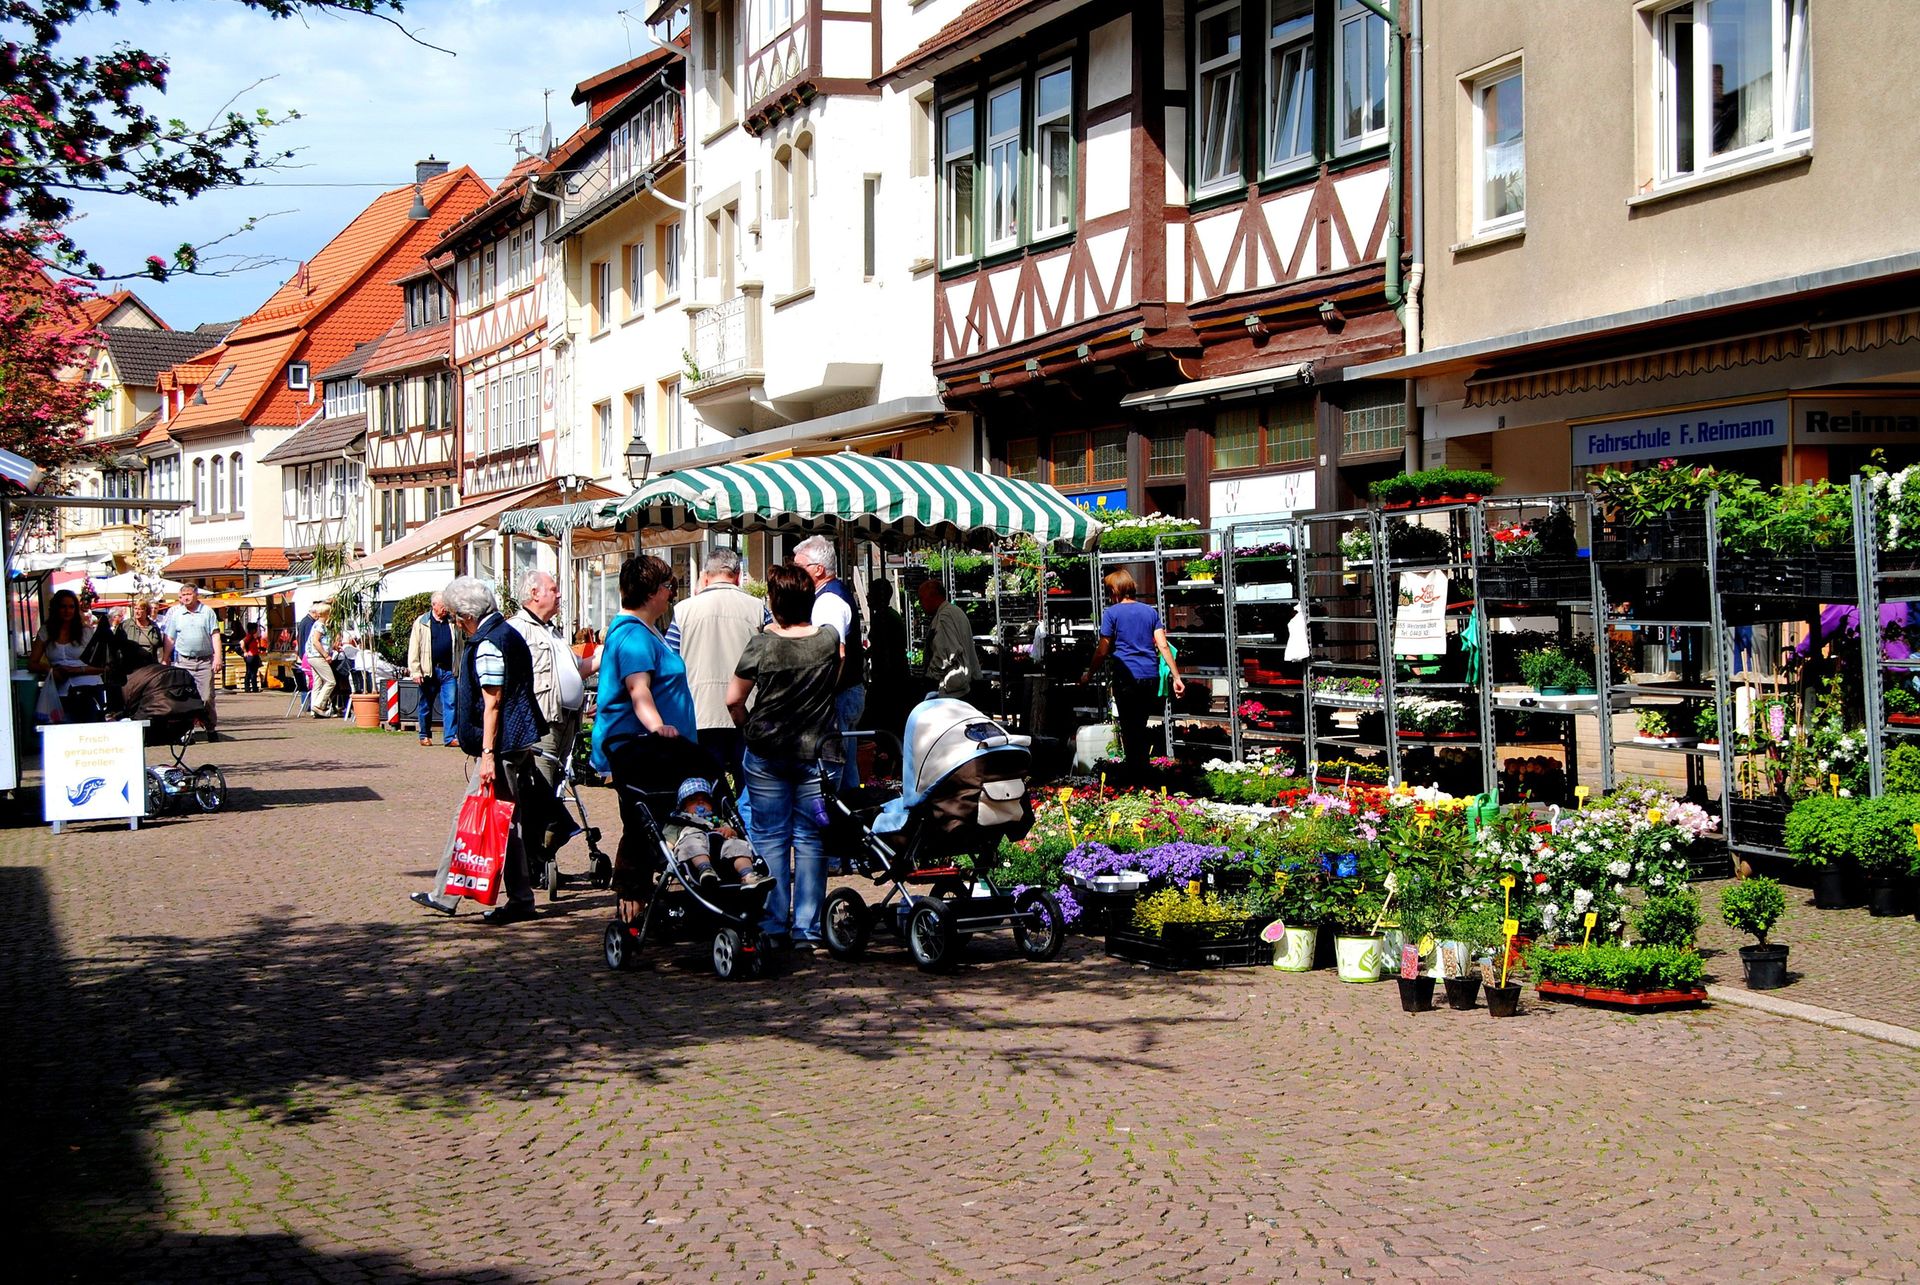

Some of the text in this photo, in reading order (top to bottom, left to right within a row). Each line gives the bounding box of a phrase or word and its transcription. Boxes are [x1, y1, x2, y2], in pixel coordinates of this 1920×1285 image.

[1588, 418, 1774, 455] Fahrschule F. Reimann
[78, 735, 110, 743] Frisch
[75, 759, 115, 767] Forellen
